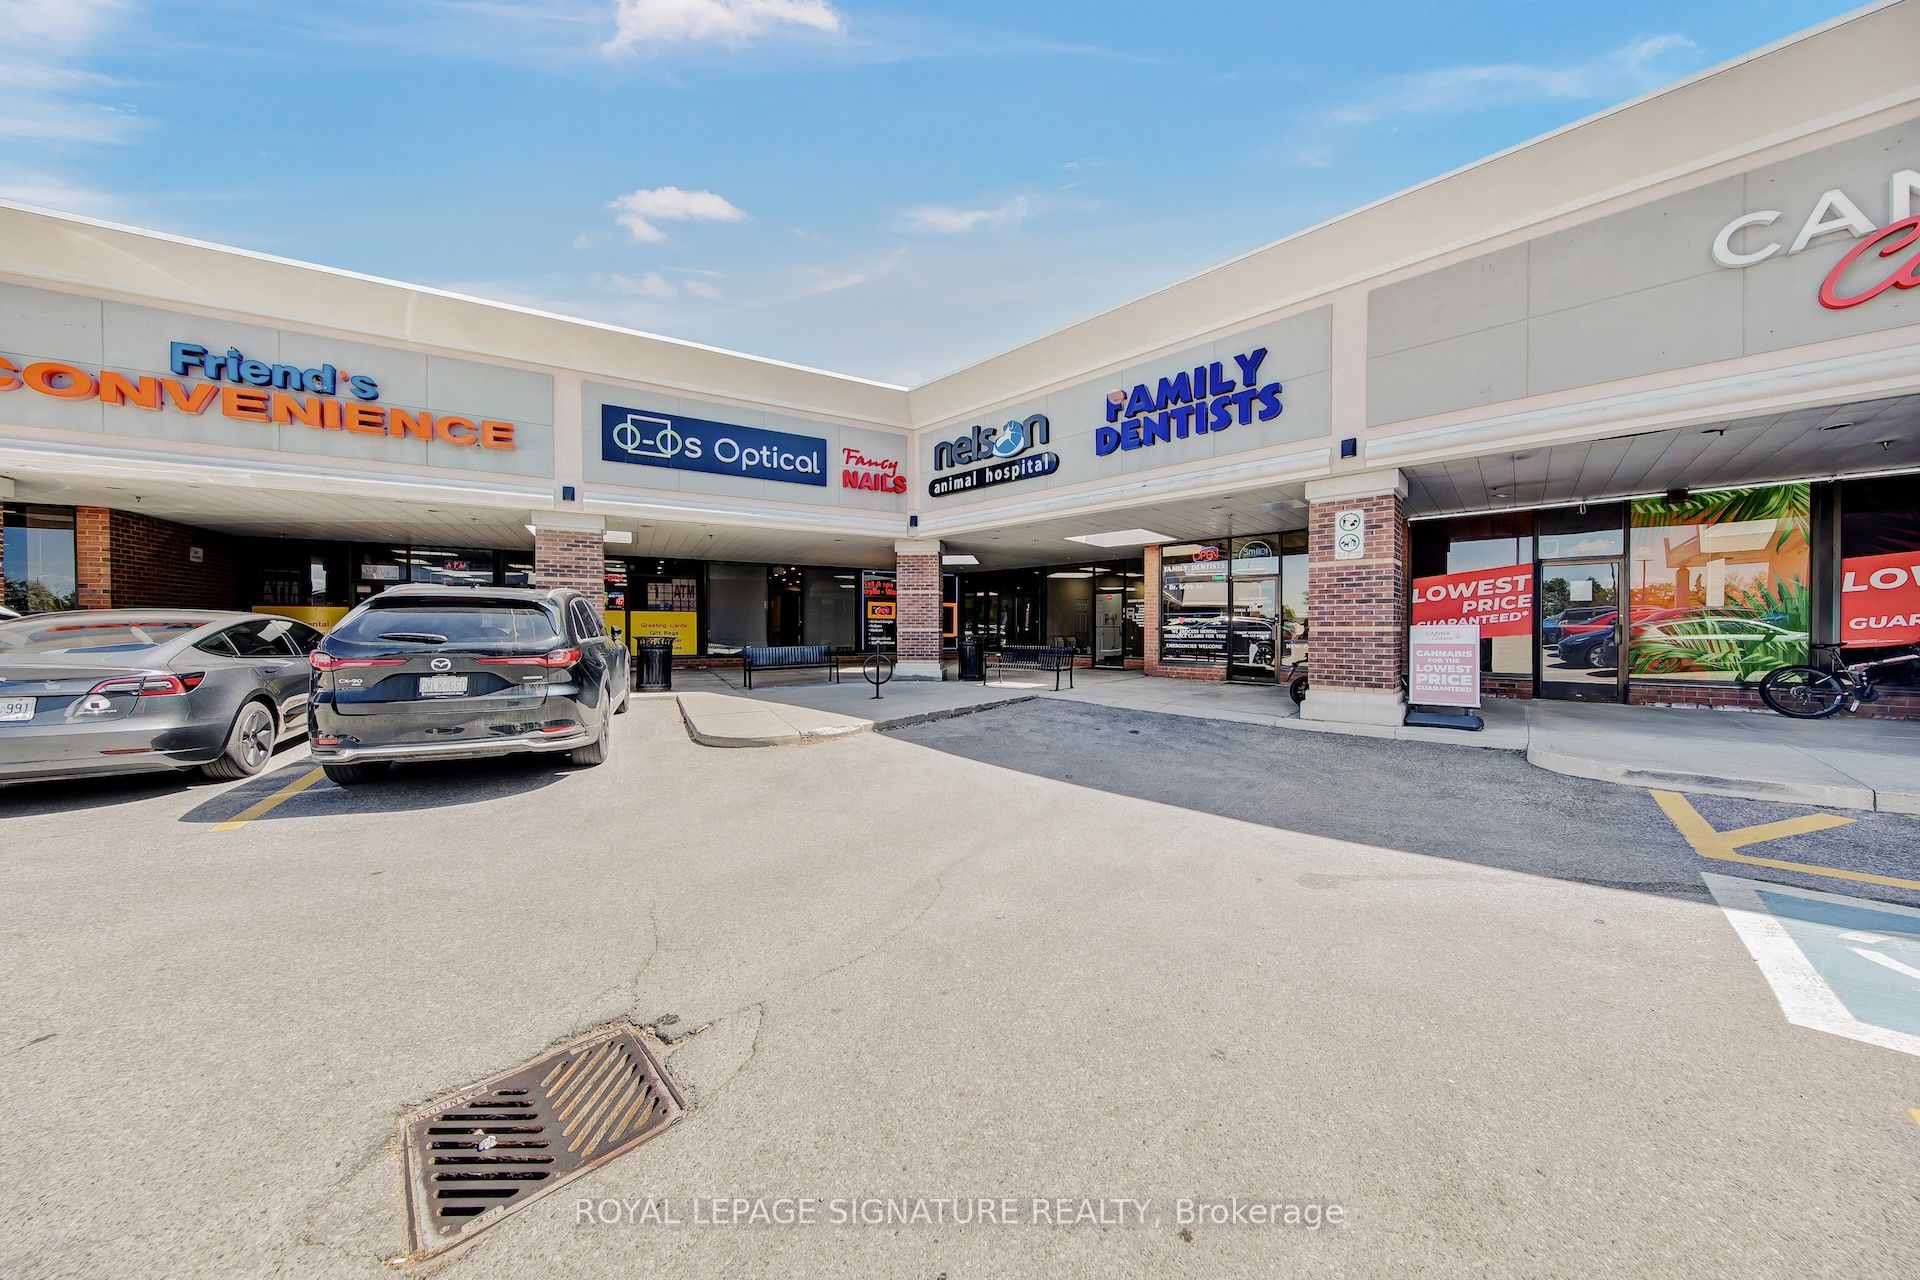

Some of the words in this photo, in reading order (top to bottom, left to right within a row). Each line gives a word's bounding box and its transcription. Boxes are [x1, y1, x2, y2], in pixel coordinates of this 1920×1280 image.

[170, 341, 380, 401] Friend's
[1106, 347, 1268, 423] FAMILY
[1095, 382, 1283, 457] DENTISTS
[934, 413, 1050, 471] nelson
[714, 438, 821, 475] Optical
[842, 447, 898, 477] Fancy
[842, 470, 907, 494] NAILS
[933, 470, 977, 494] animal
[985, 453, 1049, 483] hospital
[1191, 562, 1225, 571] DENTISTS
[1193, 550, 1219, 561] OPEN
[673, 584, 695, 599] ATM
[1412, 574, 1533, 604] LOWEST
[1842, 566, 1920, 592] LO
[1462, 593, 1532, 614] PRICE
[1416, 650, 1473, 658] CANNABIS
[1416, 664, 1473, 673] LOWEST
[1416, 674, 1473, 686] PRICE
[6, 703, 29, 714] 991
